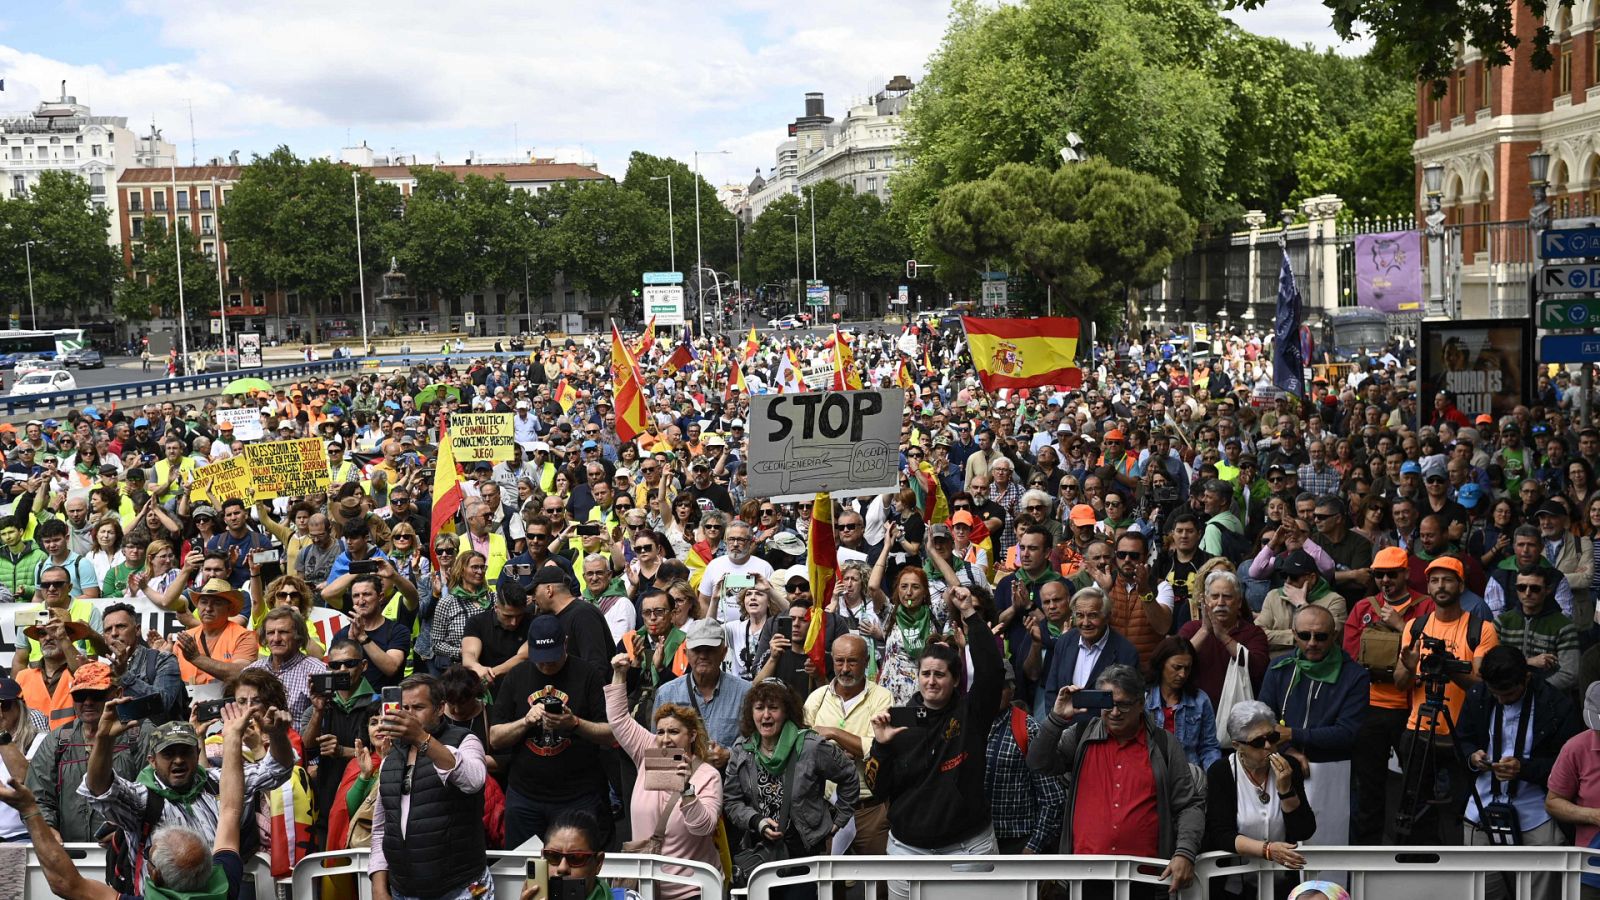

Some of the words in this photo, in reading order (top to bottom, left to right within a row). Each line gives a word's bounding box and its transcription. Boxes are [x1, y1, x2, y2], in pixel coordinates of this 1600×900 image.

[1446, 370, 1486, 393] SUDAR
[1487, 370, 1502, 393] ES
[766, 391, 882, 442] STOP
[460, 425, 500, 436] CRIMINALES
[452, 435, 489, 448] CONOCEMOS
[490, 435, 514, 446] VUESTRO
[247, 446, 258, 458] NO
[258, 444, 268, 457] ES
[290, 442, 298, 453] ES
[472, 448, 494, 459] JUEGO
[856, 447, 887, 458] AGENDA
[275, 455, 283, 464] EN
[284, 453, 300, 464] PLENA
[200, 463, 222, 477] POLICIA
[221, 459, 237, 471] DEBE
[271, 463, 298, 473] EMBALSES
[298, 462, 302, 472] Y
[303, 459, 327, 471] DERRIBAN
[856, 458, 883, 473] 2030
[216, 466, 246, 482] PROTEGER
[302, 470, 314, 480] SON
[315, 468, 329, 478] ESAS
[258, 482, 282, 492] ESTELAS
